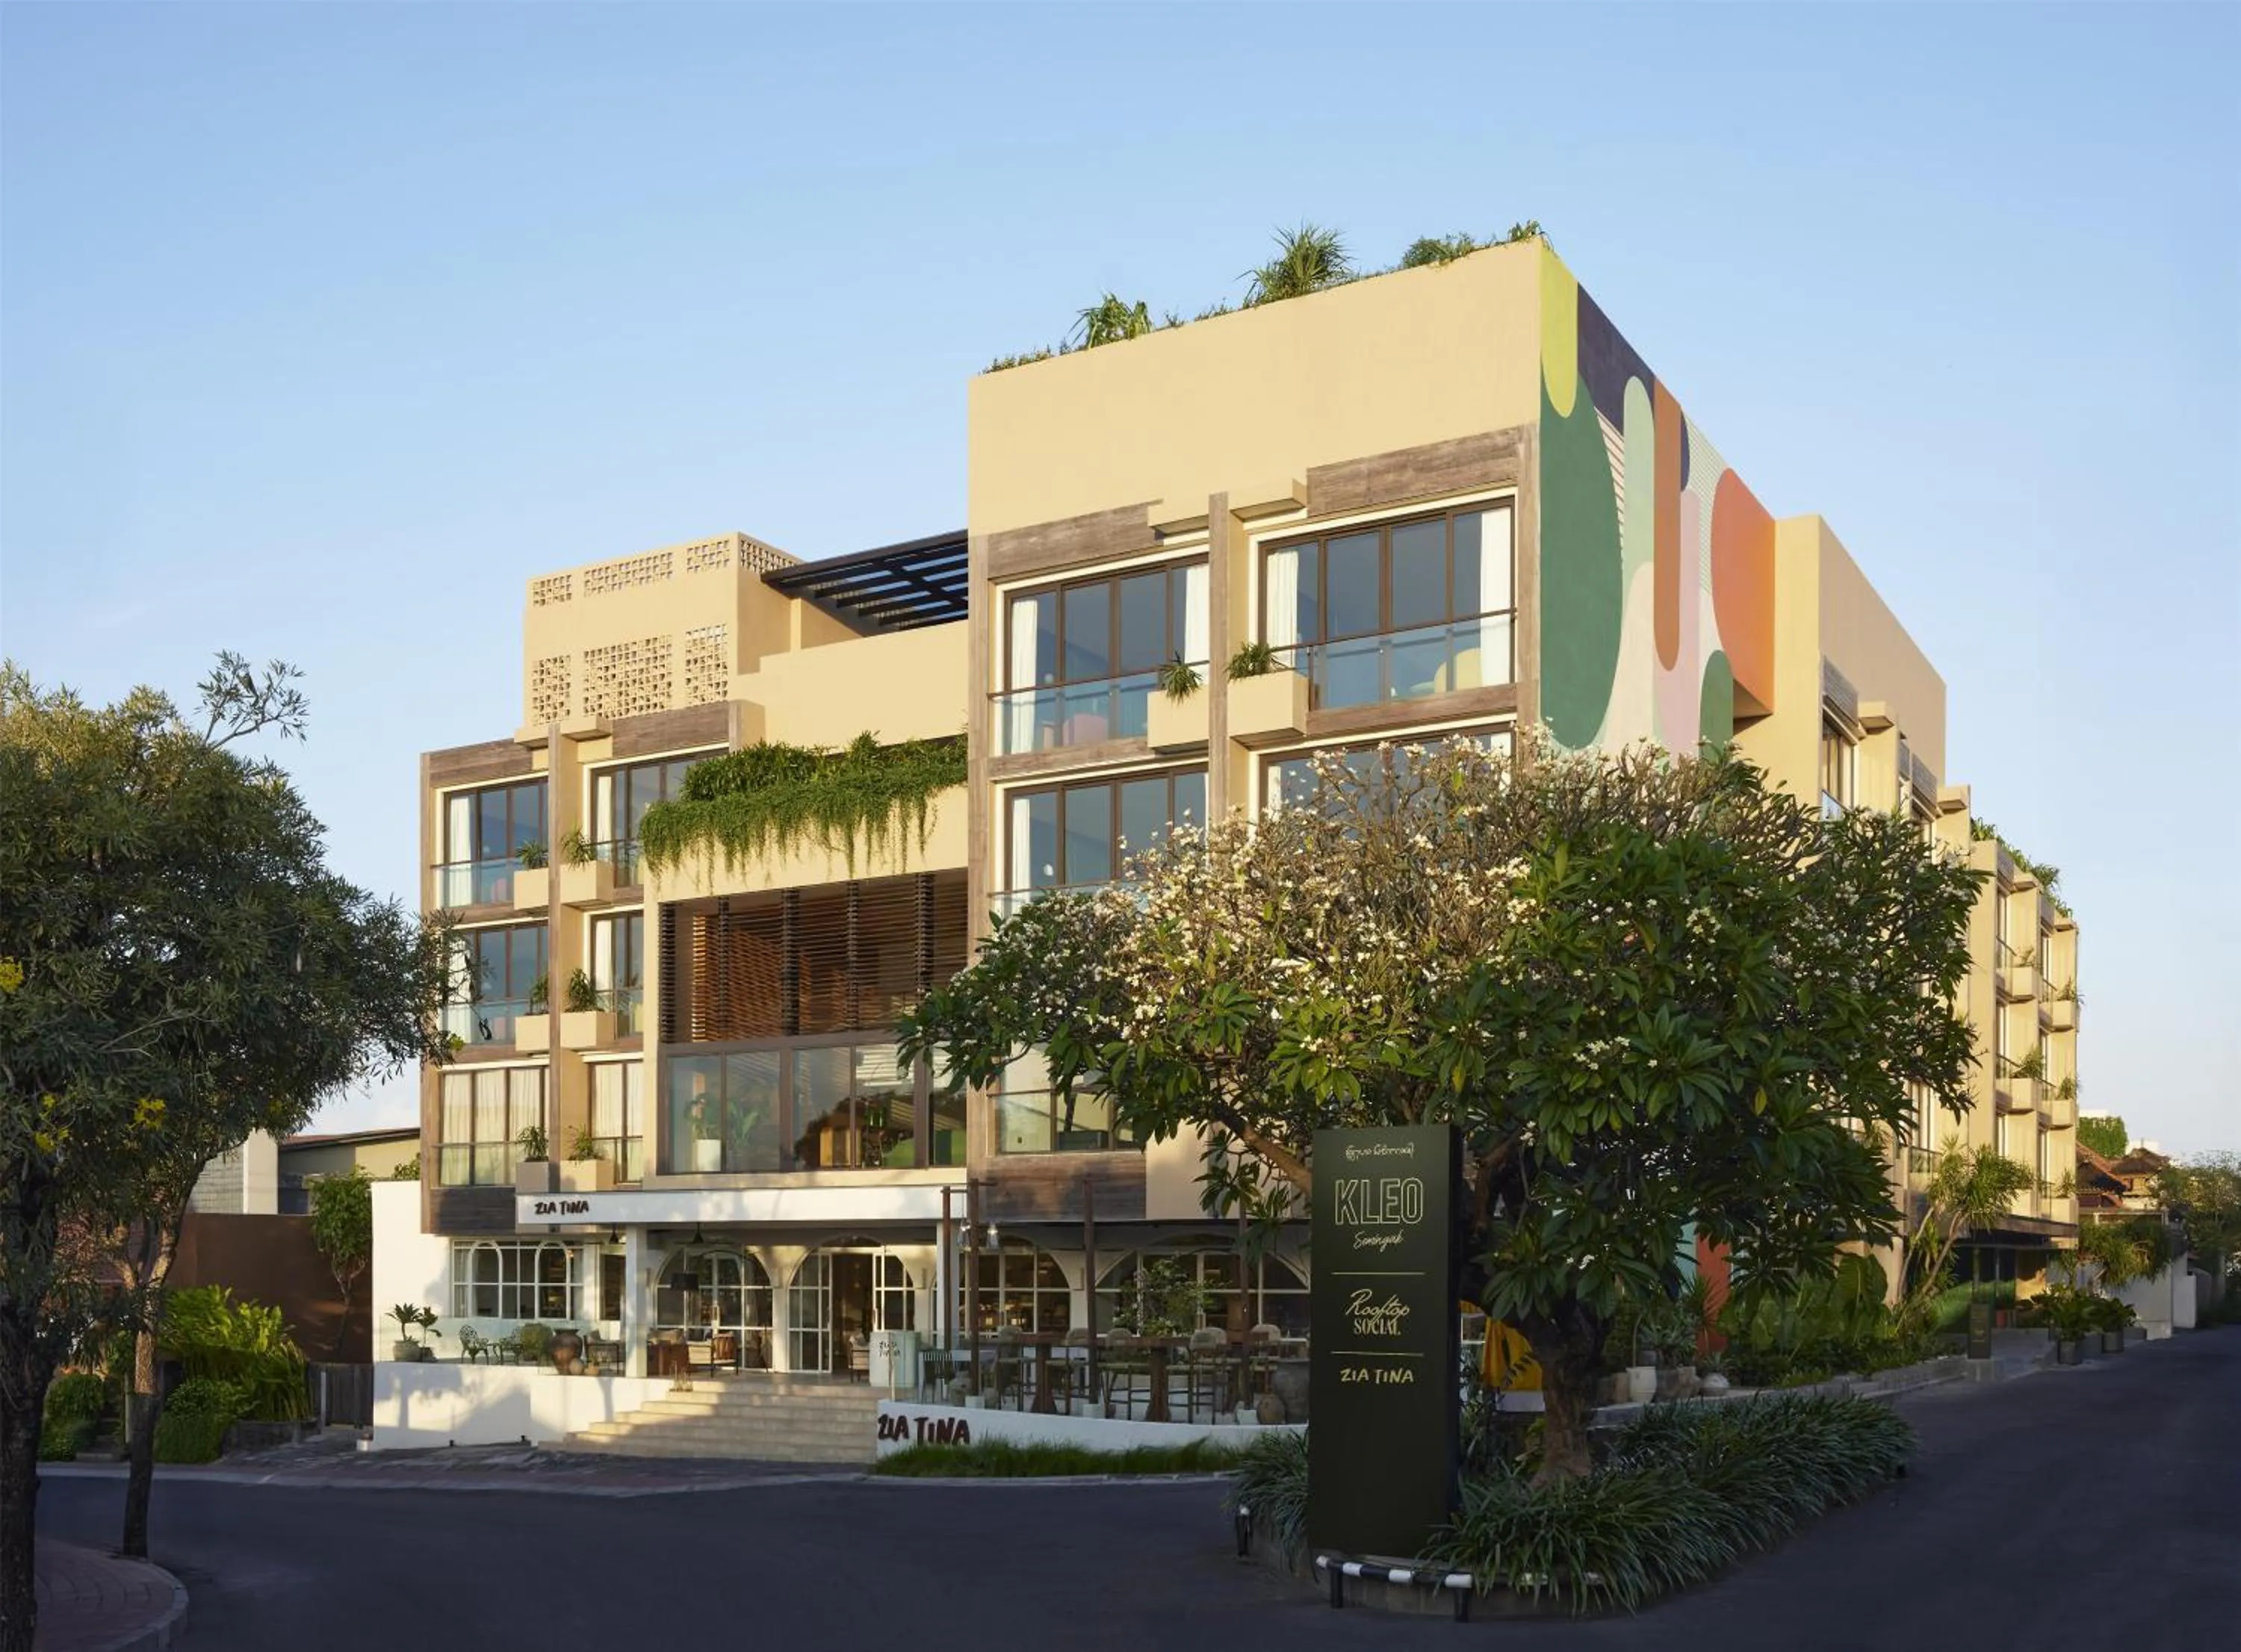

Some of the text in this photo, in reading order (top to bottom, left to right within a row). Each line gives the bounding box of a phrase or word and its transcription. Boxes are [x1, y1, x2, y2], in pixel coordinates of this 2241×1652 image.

[535, 1200, 589, 1215] ZIA TINA
[1335, 1177, 1423, 1226] KLEO
[1345, 1288, 1410, 1325] Rooftop
[1354, 1317, 1401, 1336] SOCIAL
[1340, 1367, 1414, 1384] ZIA TINA
[878, 1414, 970, 1446] ZIA TINA
